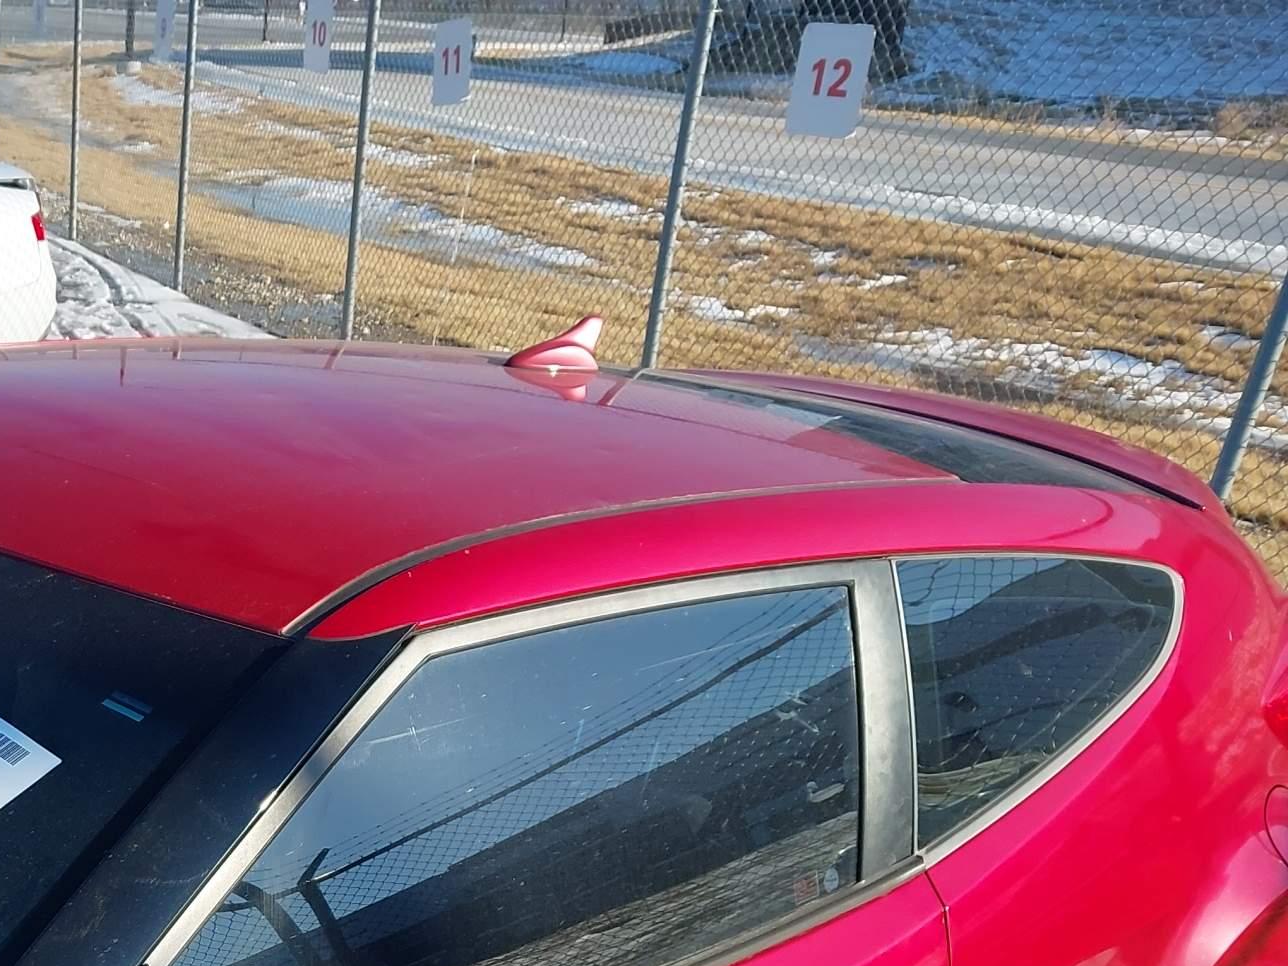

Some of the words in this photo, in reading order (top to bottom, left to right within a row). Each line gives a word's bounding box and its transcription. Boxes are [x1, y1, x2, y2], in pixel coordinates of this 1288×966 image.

[311, 20, 327, 47] 10
[441, 45, 461, 75] 11
[812, 58, 852, 98] 12
